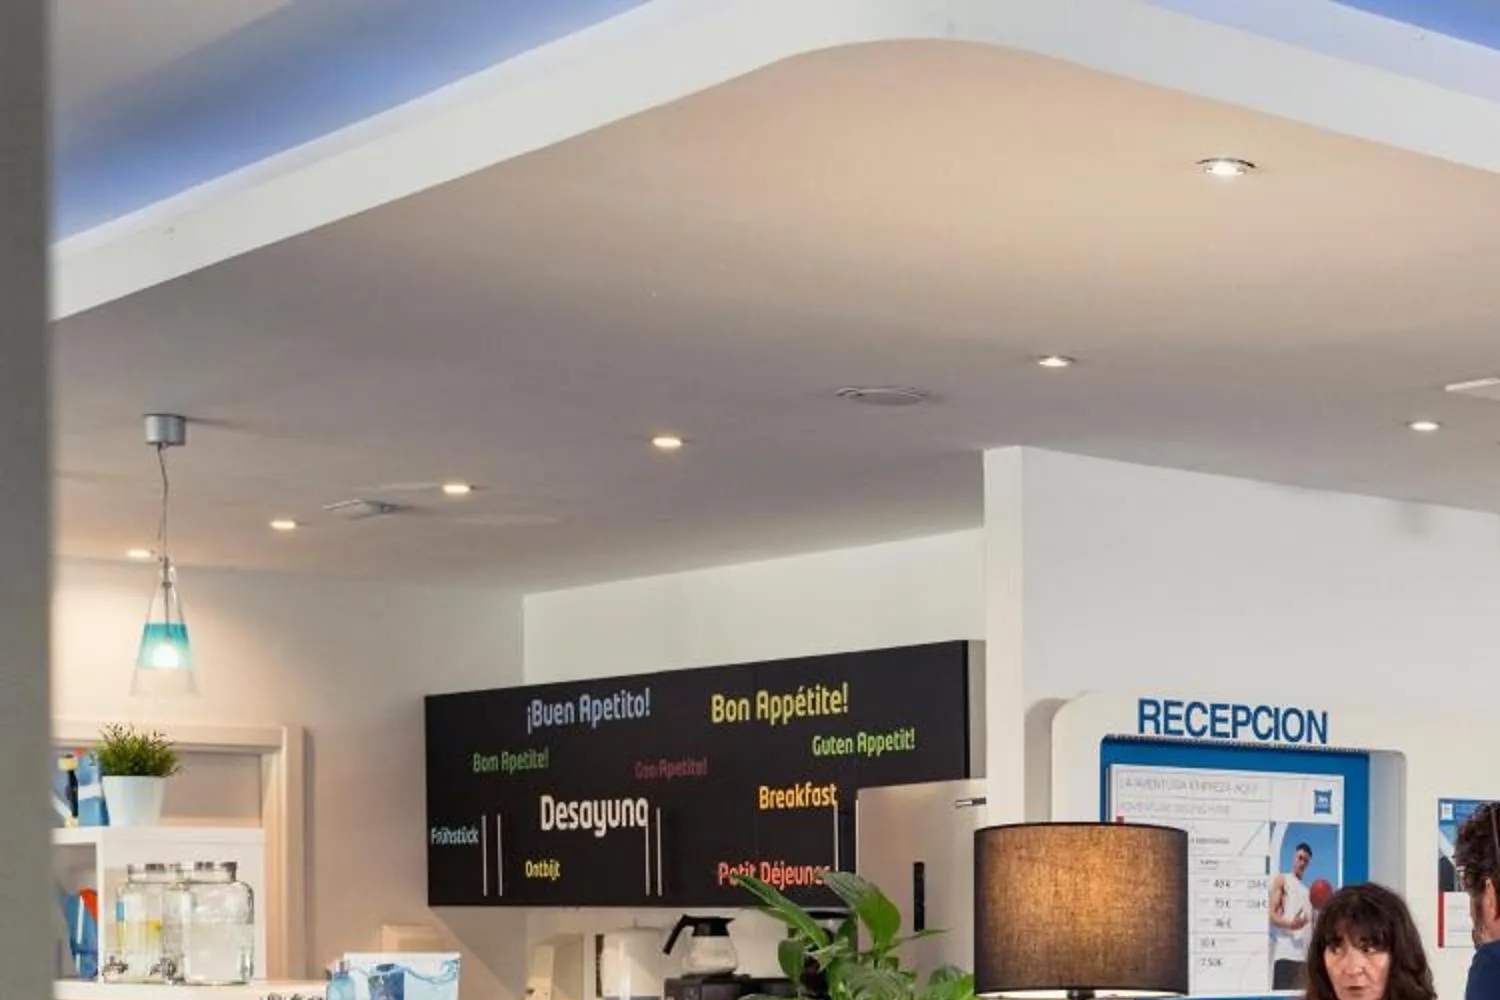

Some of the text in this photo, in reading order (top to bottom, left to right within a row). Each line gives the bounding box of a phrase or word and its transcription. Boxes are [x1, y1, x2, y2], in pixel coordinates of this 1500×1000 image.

[526, 688, 650, 735] ¡Buen Apetito!
[711, 681, 848, 726] Bon Appétite!
[1137, 698, 1329, 744] RECEPCION
[812, 727, 915, 757] Guten Appetit!
[759, 781, 838, 810] Breakfast
[540, 794, 649, 838] Desayuno
[430, 825, 479, 845] Frühstück
[525, 857, 561, 881] Ontbijt
